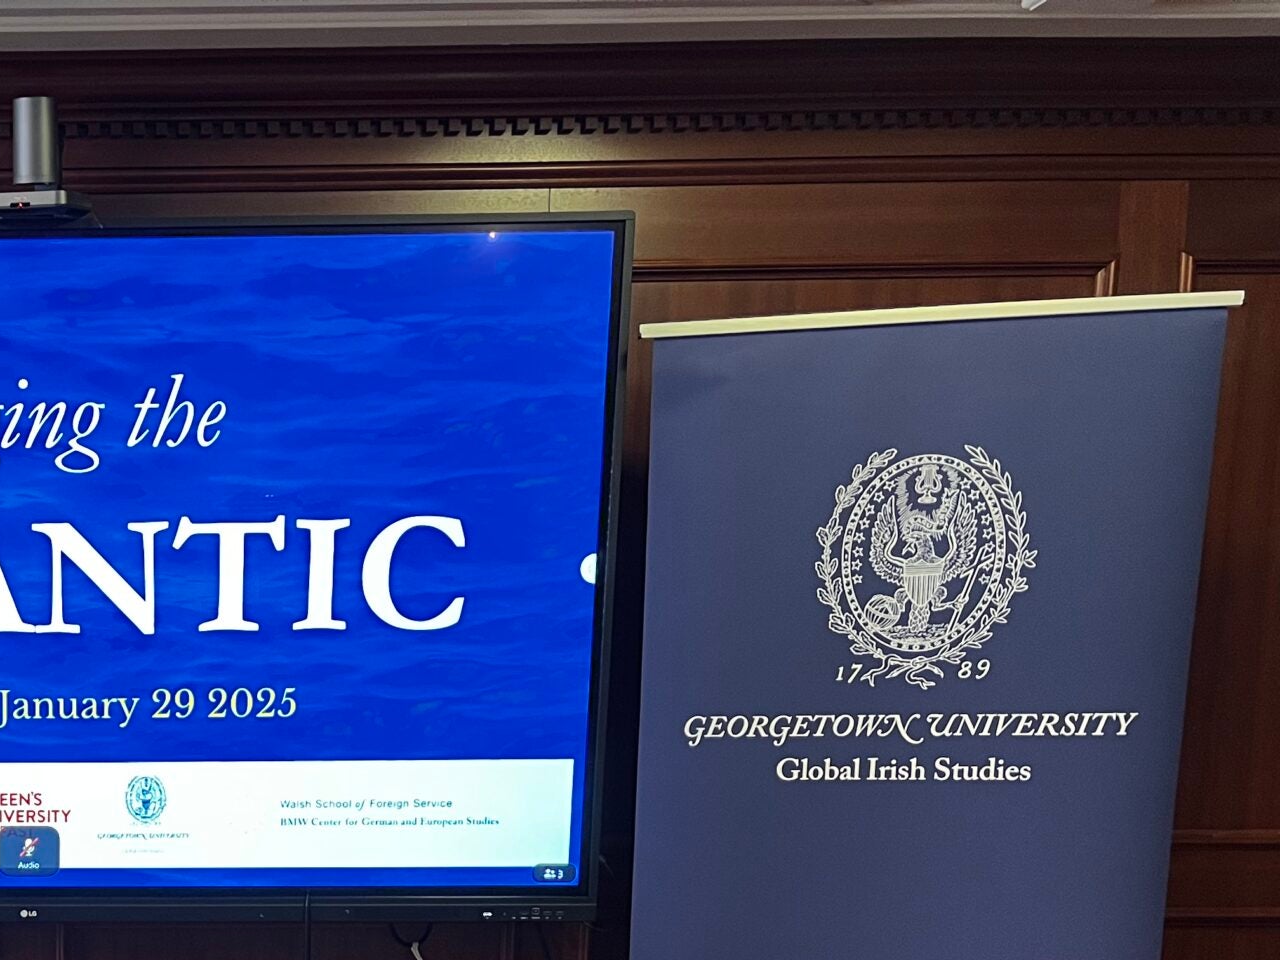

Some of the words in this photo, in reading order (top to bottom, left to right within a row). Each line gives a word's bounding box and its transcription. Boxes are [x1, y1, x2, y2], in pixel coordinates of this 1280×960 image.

[127, 374, 226, 447] the
[835, 663, 861, 684] 17
[957, 659, 991, 680] 89
[152, 689, 194, 718] 29
[208, 688, 296, 717] 2025
[684, 714, 923, 746] GEORGETOWN
[927, 713, 1138, 736] UNIVERSITY
[777, 758, 861, 780] Global
[867, 758, 926, 780] Irish
[934, 757, 1031, 780] Studies
[280, 800, 311, 809] Walsh
[315, 799, 352, 809] School
[354, 800, 365, 811] of
[369, 799, 409, 810] Foreign
[413, 798, 453, 808] Service
[280, 817, 307, 826] BMW
[311, 817, 341, 826] Center
[345, 818, 358, 826] for
[361, 817, 398, 826] German
[400, 817, 418, 826] and
[420, 817, 464, 828] European
[466, 816, 500, 825] Studies
[17, 861, 40, 869] Audio
[557, 869, 564, 880] 3
